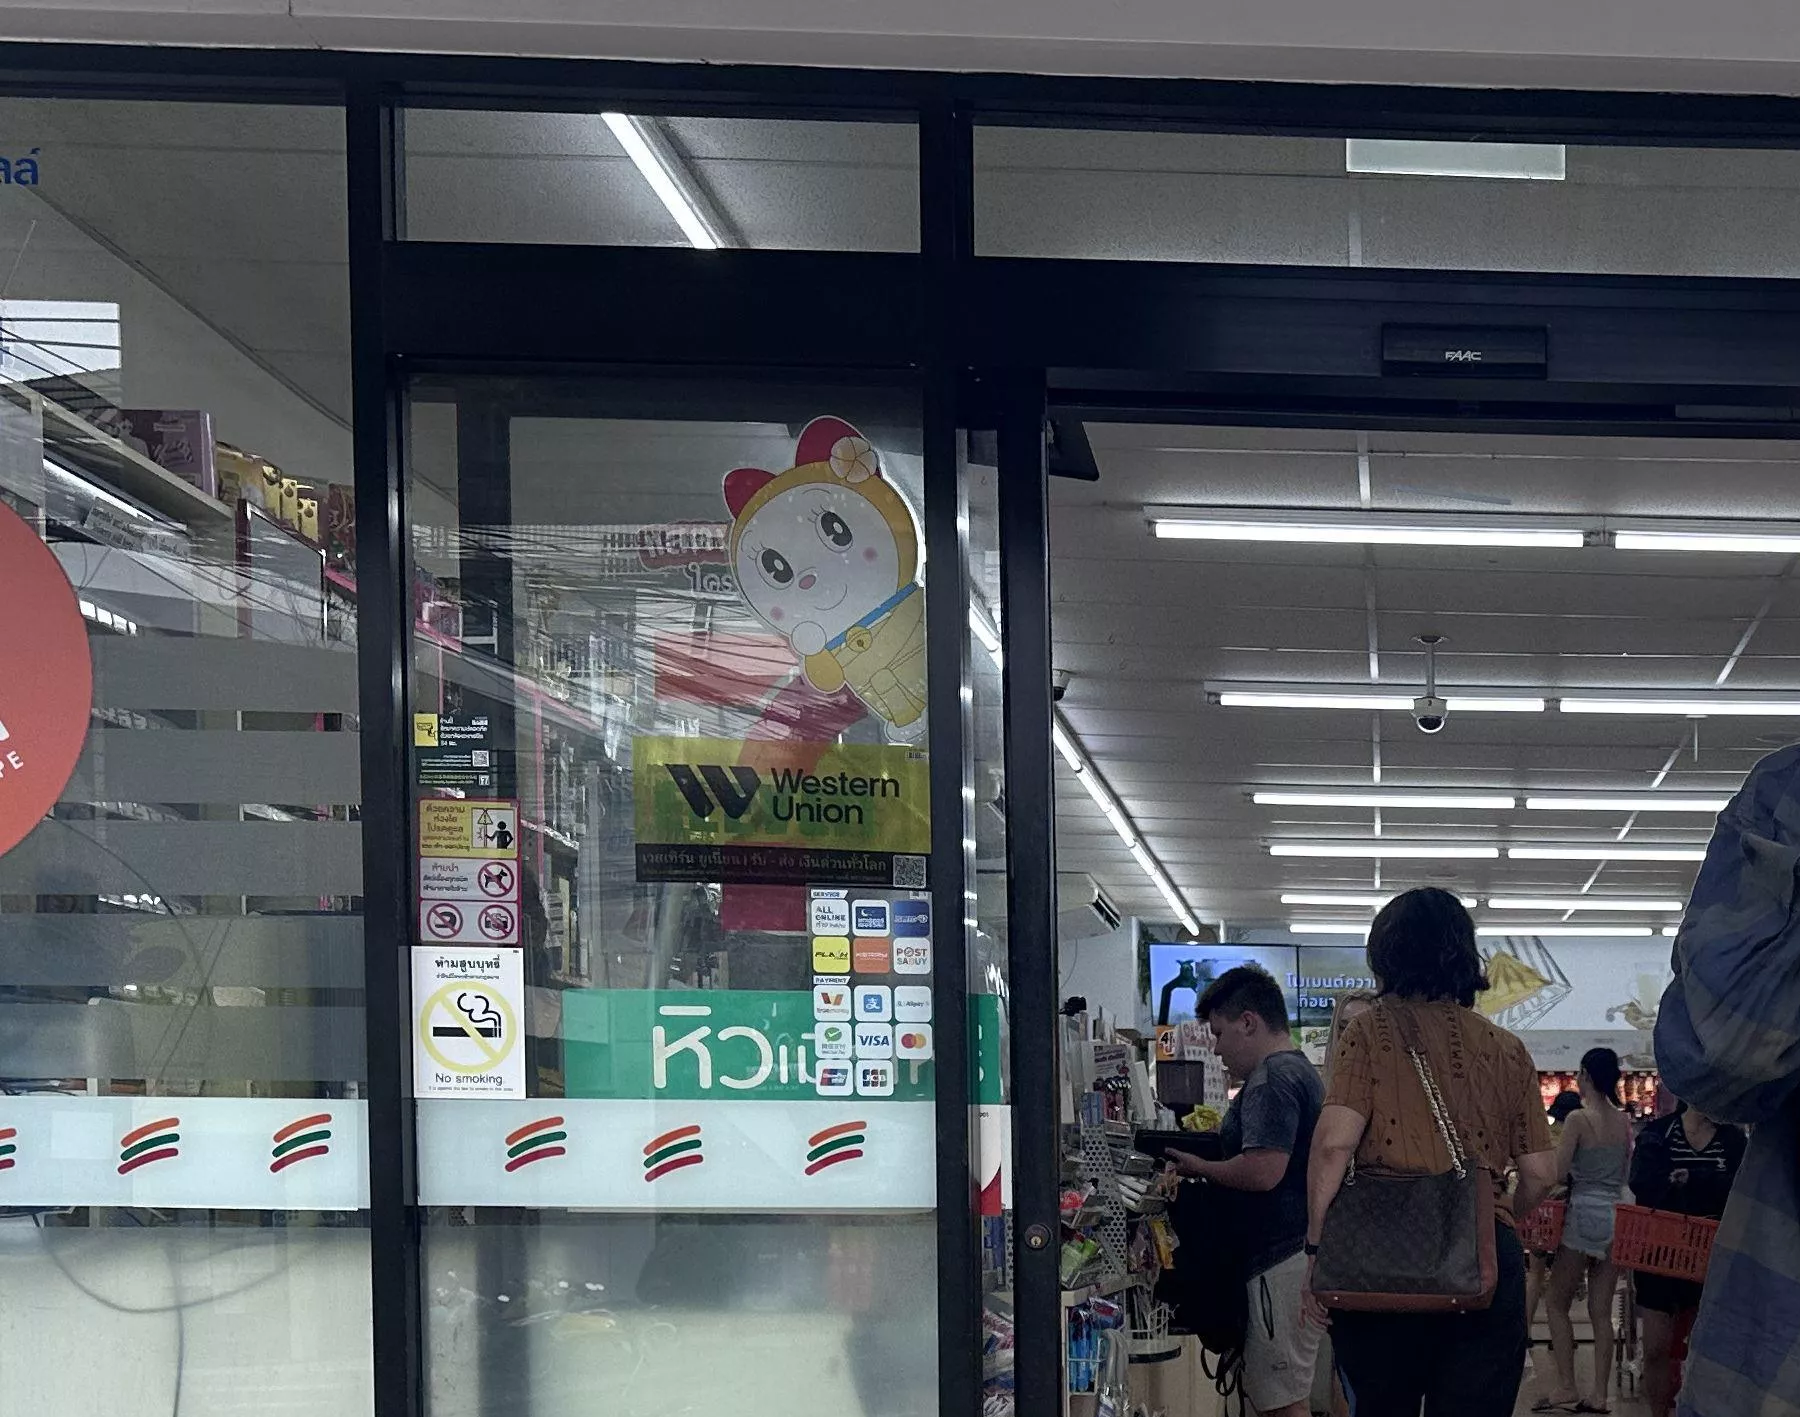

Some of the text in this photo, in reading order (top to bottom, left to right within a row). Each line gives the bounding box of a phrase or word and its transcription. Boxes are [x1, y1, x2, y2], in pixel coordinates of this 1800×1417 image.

[1445, 350, 1482, 361] FAAC
[770, 766, 900, 798] Western
[772, 796, 864, 825] Union
[816, 906, 833, 914] ALL
[897, 947, 928, 957] POST
[434, 954, 501, 972] ห้ามสูบบุหรี่
[1285, 972, 1376, 989] โมเมนต์ควา
[857, 1034, 890, 1047] VISA
[435, 1073, 503, 1087] No smoking
